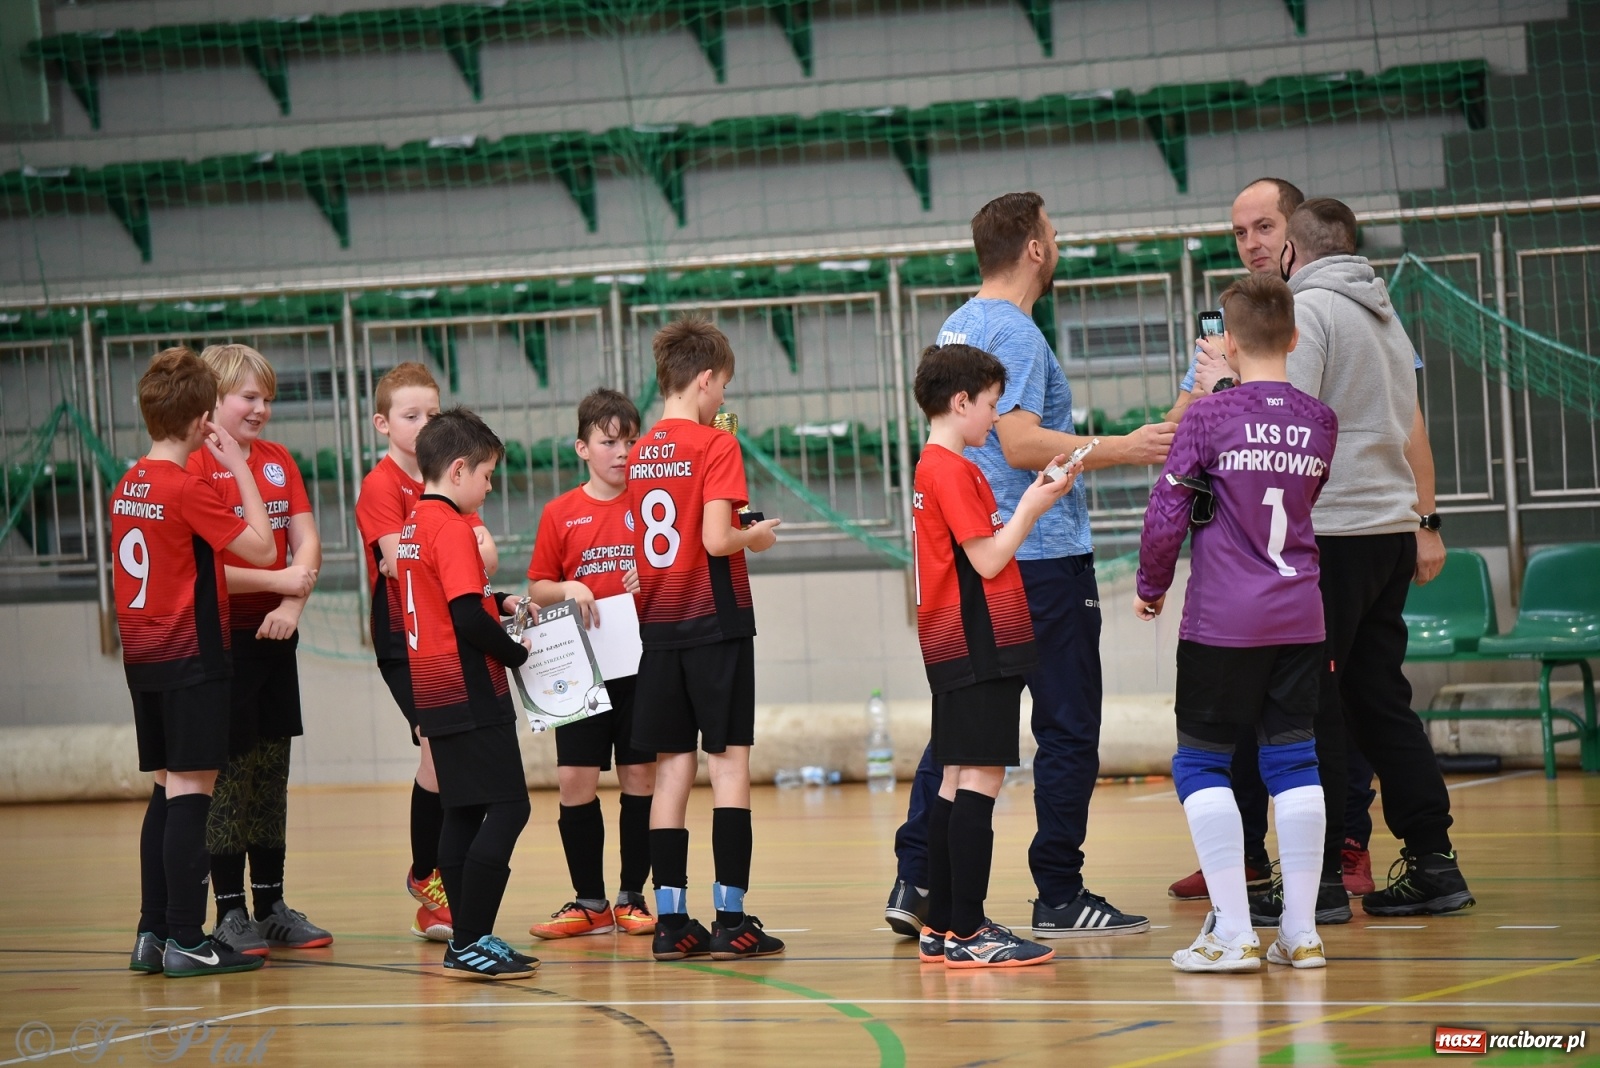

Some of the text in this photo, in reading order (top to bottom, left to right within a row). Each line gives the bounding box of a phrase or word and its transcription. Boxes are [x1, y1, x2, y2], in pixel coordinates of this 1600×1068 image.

[1266, 397, 1284, 407] 1907
[1245, 423, 1312, 448] LKS 07
[639, 443, 676, 460] LKS 07
[1218, 449, 1327, 477] MARKOWICE
[640, 487, 681, 570] 8
[1261, 487, 1298, 577] 1
[118, 526, 150, 609] 9
